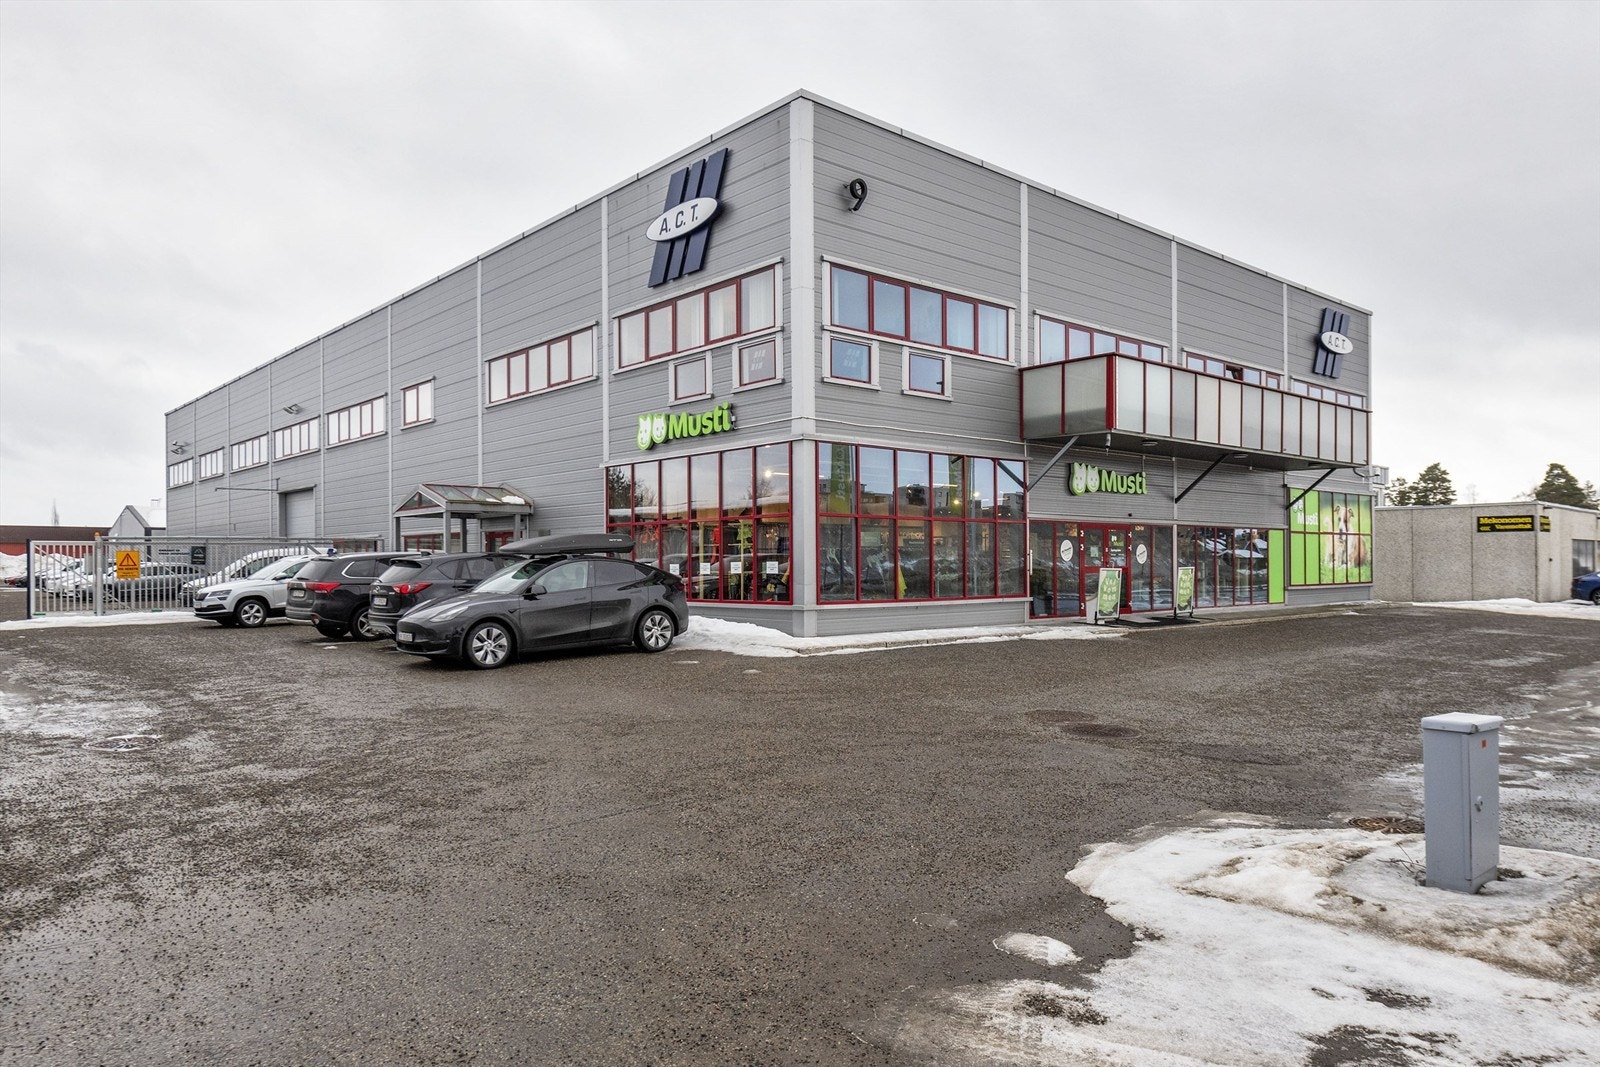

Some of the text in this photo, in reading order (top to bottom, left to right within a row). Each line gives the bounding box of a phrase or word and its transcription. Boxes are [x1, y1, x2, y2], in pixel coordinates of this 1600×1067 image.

[850, 178, 868, 212] 9
[668, 401, 731, 440] Musti
[1101, 469, 1148, 494] Musti
[1297, 512, 1319, 526] Musti
